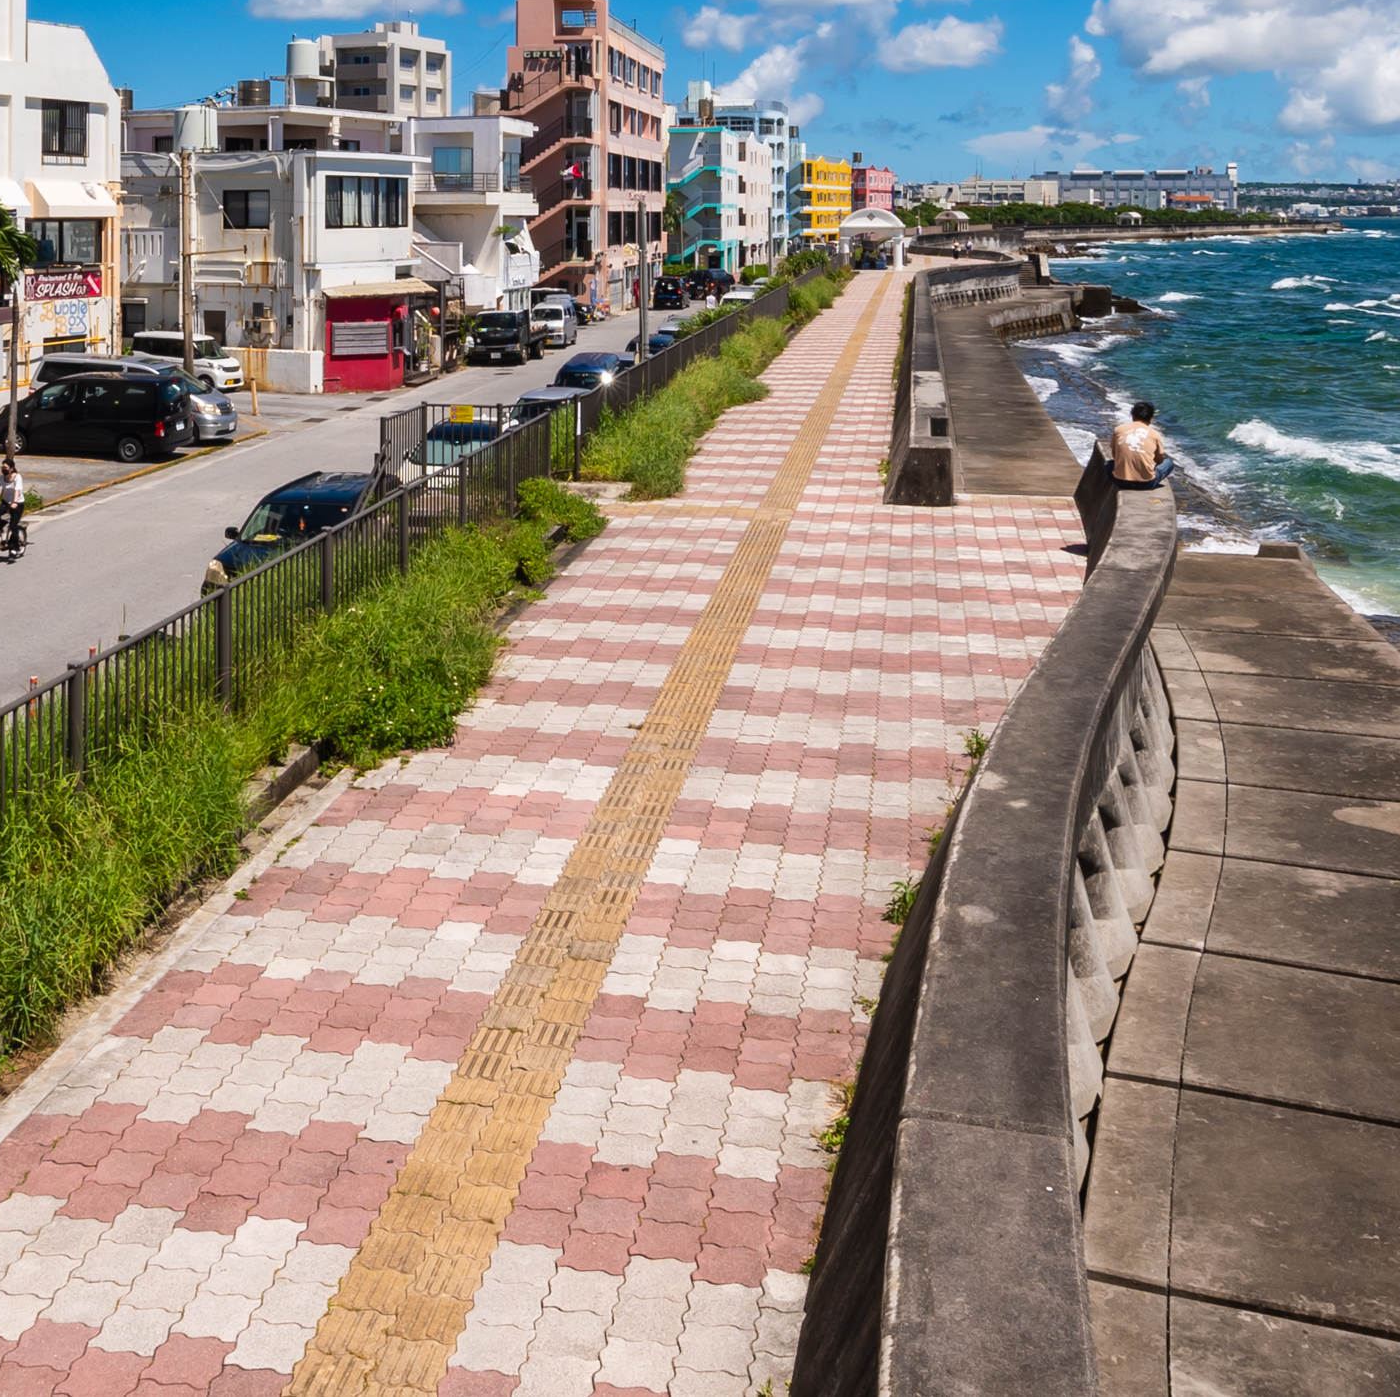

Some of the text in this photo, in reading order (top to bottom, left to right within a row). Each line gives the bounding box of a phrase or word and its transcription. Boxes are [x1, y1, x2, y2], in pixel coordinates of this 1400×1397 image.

[35, 283, 77, 298] SPLASH
[39, 300, 88, 323] Bubble
[53, 315, 87, 335] Box
